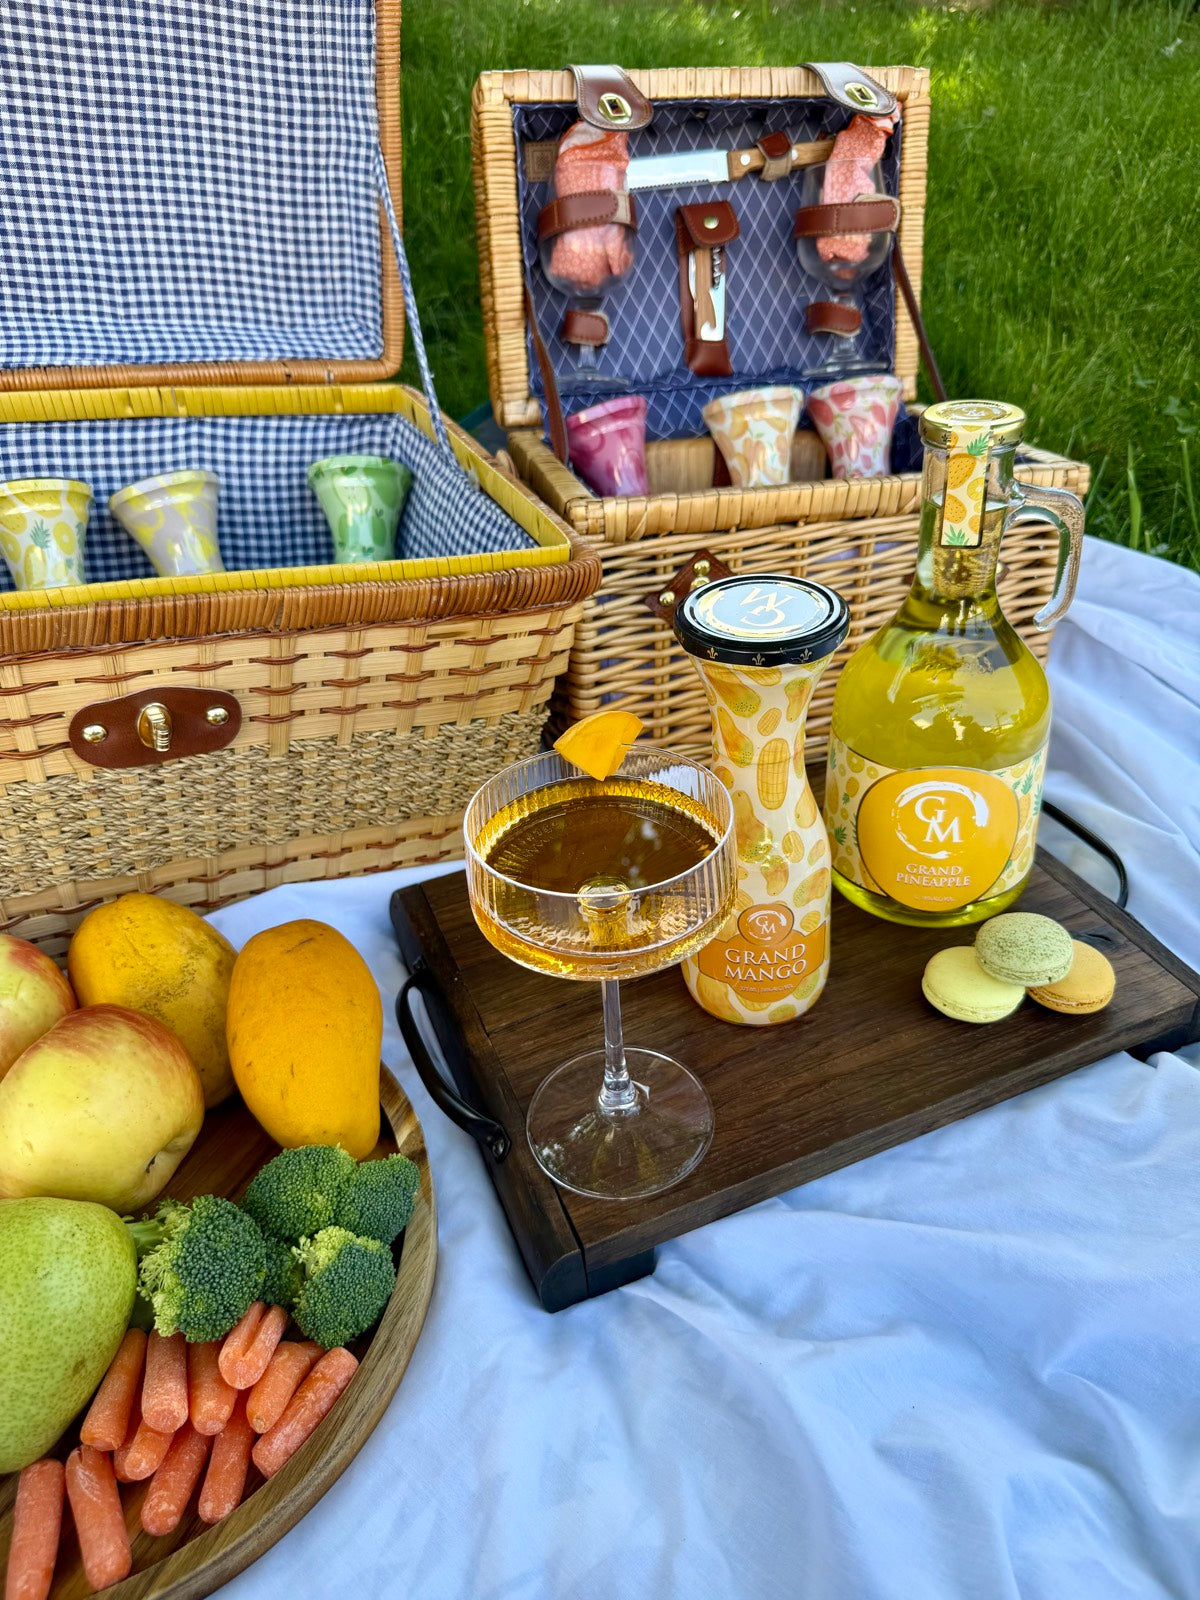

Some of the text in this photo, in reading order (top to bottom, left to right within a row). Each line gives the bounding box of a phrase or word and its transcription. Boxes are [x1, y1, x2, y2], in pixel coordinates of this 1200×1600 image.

[915, 795, 963, 843] GM
[896, 872, 971, 887] PINEAPPLE
[905, 863, 963, 877] GRAND
[725, 943, 806, 965] GRAND
[724, 959, 807, 982] MANGO
